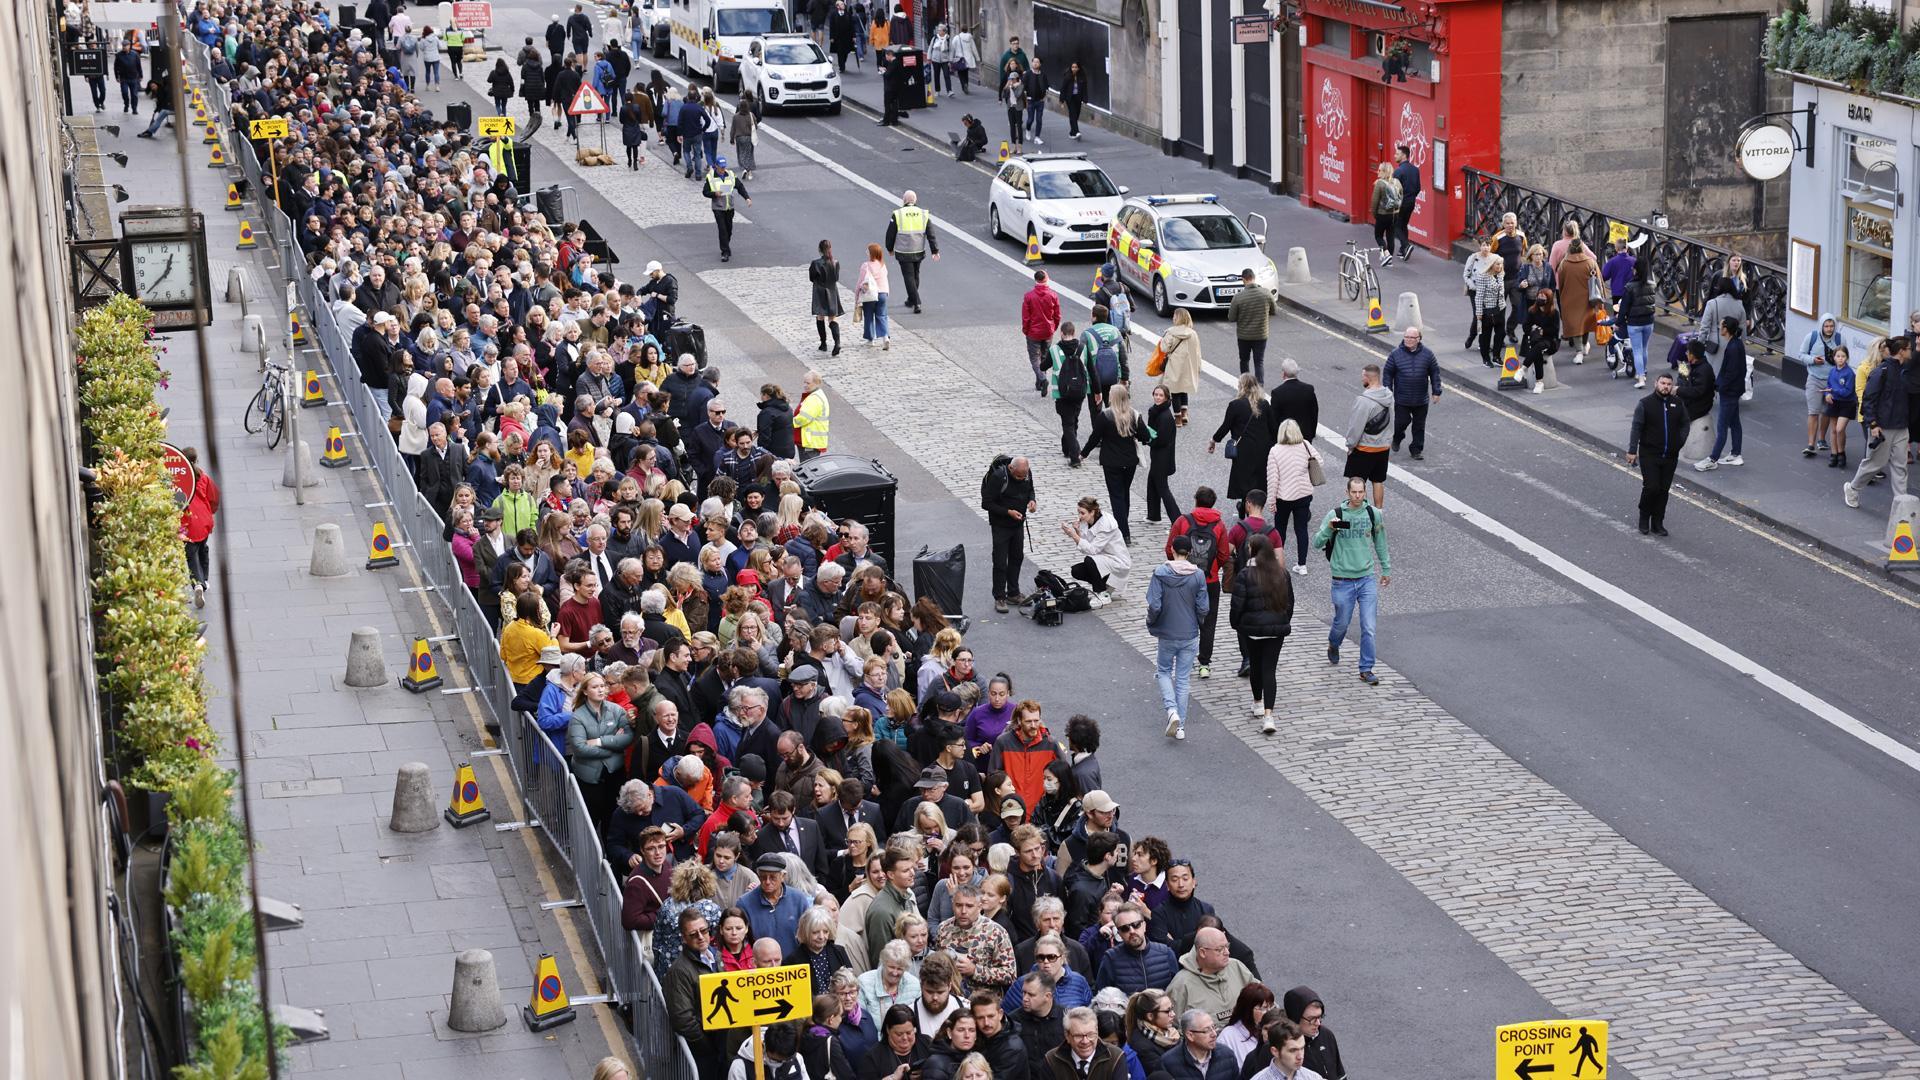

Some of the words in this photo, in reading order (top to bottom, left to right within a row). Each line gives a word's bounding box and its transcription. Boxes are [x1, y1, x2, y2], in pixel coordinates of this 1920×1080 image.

[1848, 104, 1872, 123] BAR
[1328, 141, 1337, 156] the
[1745, 147, 1790, 157] VITTORIA
[1320, 152, 1345, 172] elephant
[1322, 165, 1340, 184] house
[1340, 529, 1365, 539] SURF
[736, 968, 807, 988] CROSSING
[753, 985, 792, 1000] POINT
[1500, 1027, 1571, 1042] CROSSING
[1515, 1043, 1554, 1056] POINT
